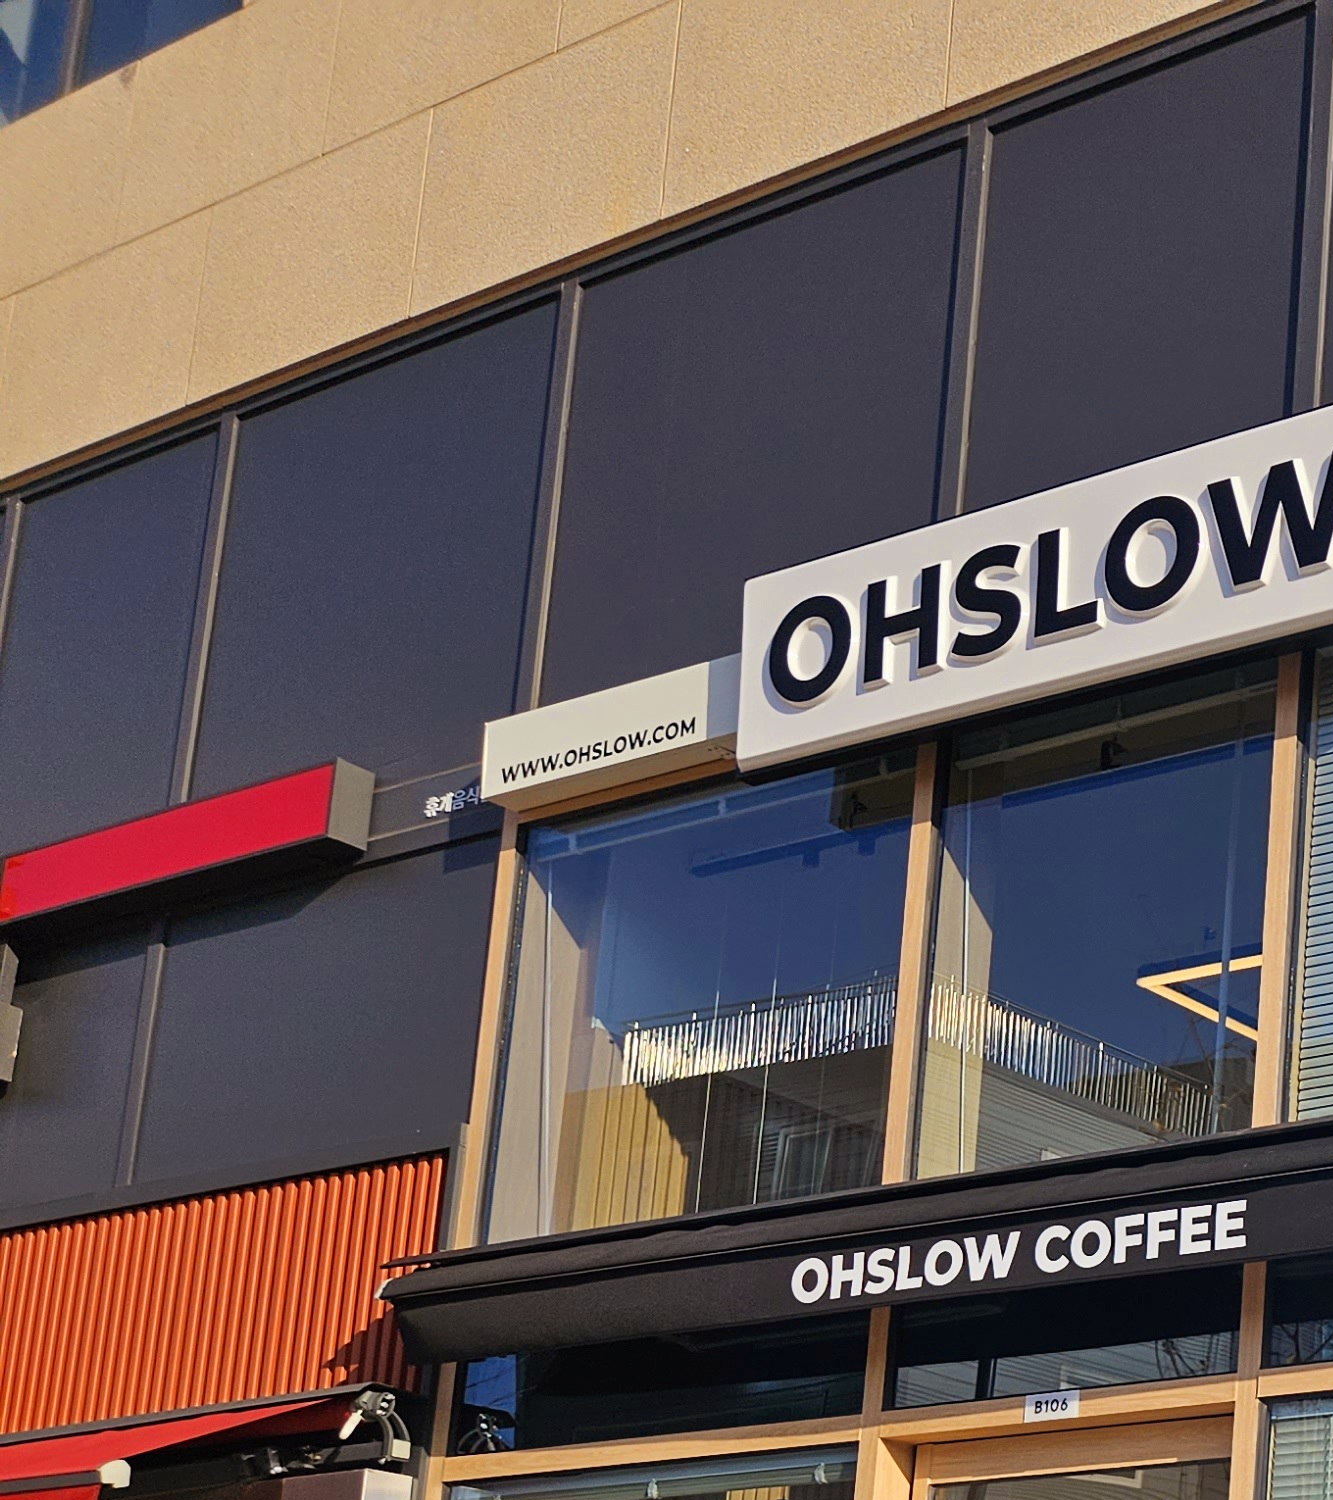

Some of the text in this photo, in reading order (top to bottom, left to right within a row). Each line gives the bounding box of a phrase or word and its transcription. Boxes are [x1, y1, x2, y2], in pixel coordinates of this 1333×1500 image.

[501, 716, 697, 784] WWW.OHSLOW.COM
[424, 785, 485, 818] 휴게음식
[790, 1198, 1248, 1304] OHSLOW COFFEE
[1034, 1397, 1068, 1414] B106
